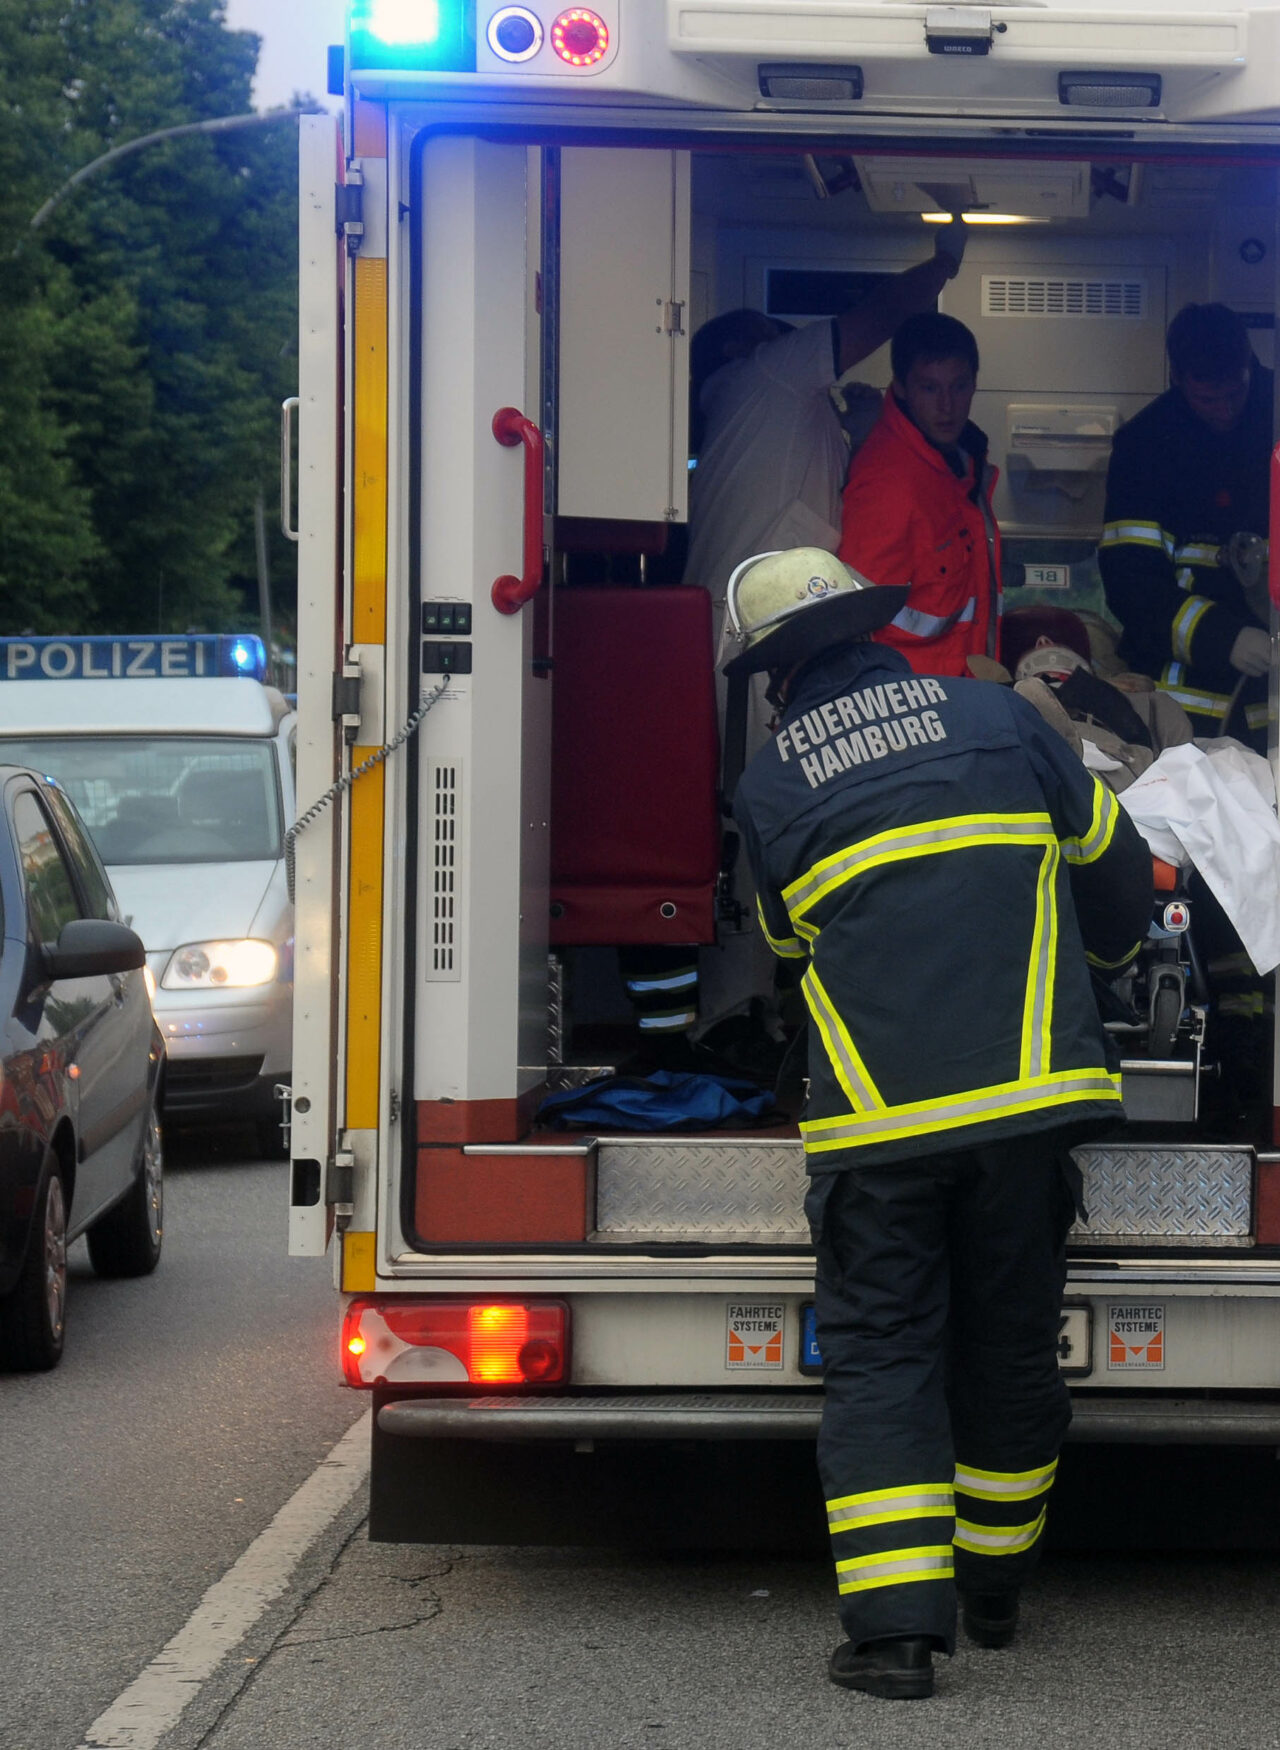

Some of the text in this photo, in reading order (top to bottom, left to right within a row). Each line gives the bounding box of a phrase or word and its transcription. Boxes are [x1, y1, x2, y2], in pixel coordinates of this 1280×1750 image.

[7, 641, 205, 679] POLIZEI
[775, 678, 948, 763] FEUERWEHR
[799, 710, 948, 790] HAMBURG
[729, 1306, 782, 1319] FAHRTEC
[1110, 1307, 1162, 1320] FAHRTEC
[733, 1320, 778, 1332] SYSTEME
[1114, 1321, 1159, 1333] SYSTEME
